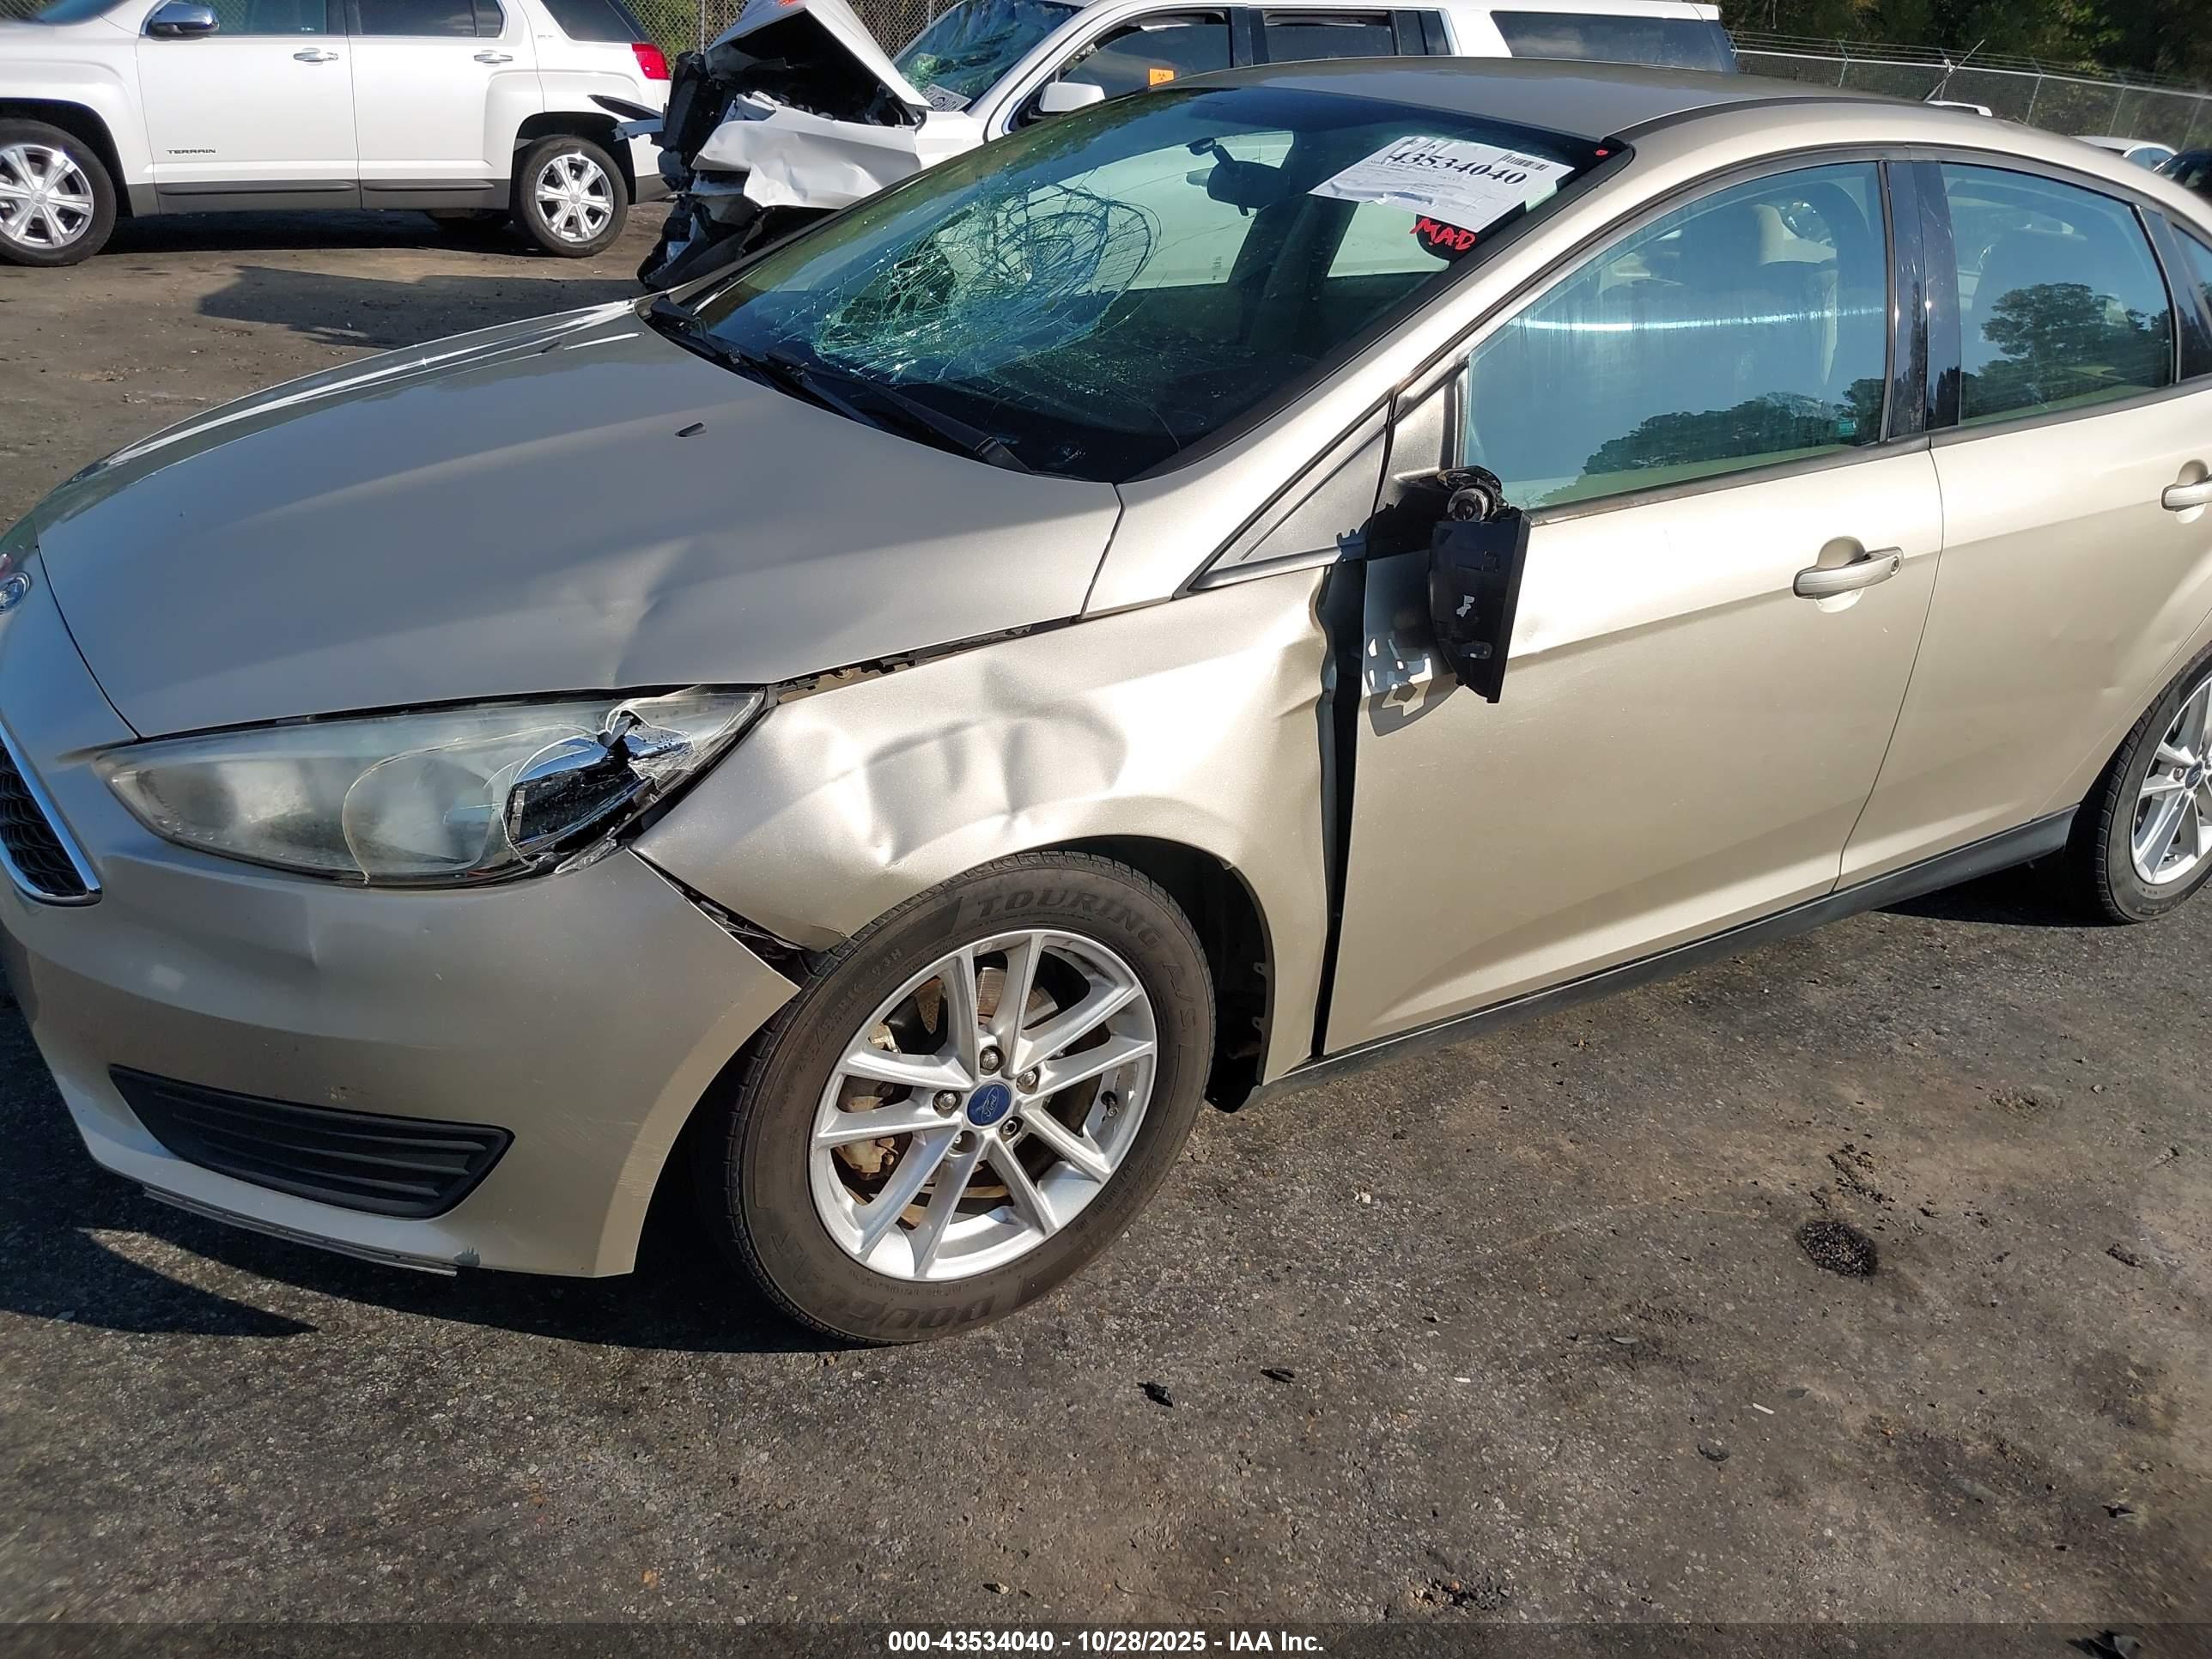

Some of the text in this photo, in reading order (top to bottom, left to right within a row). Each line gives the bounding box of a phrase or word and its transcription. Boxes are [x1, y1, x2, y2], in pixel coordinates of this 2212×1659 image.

[1387, 151, 1528, 185] 43534040
[1409, 217, 1476, 250] MAD
[980, 888, 1160, 948] TOURING
